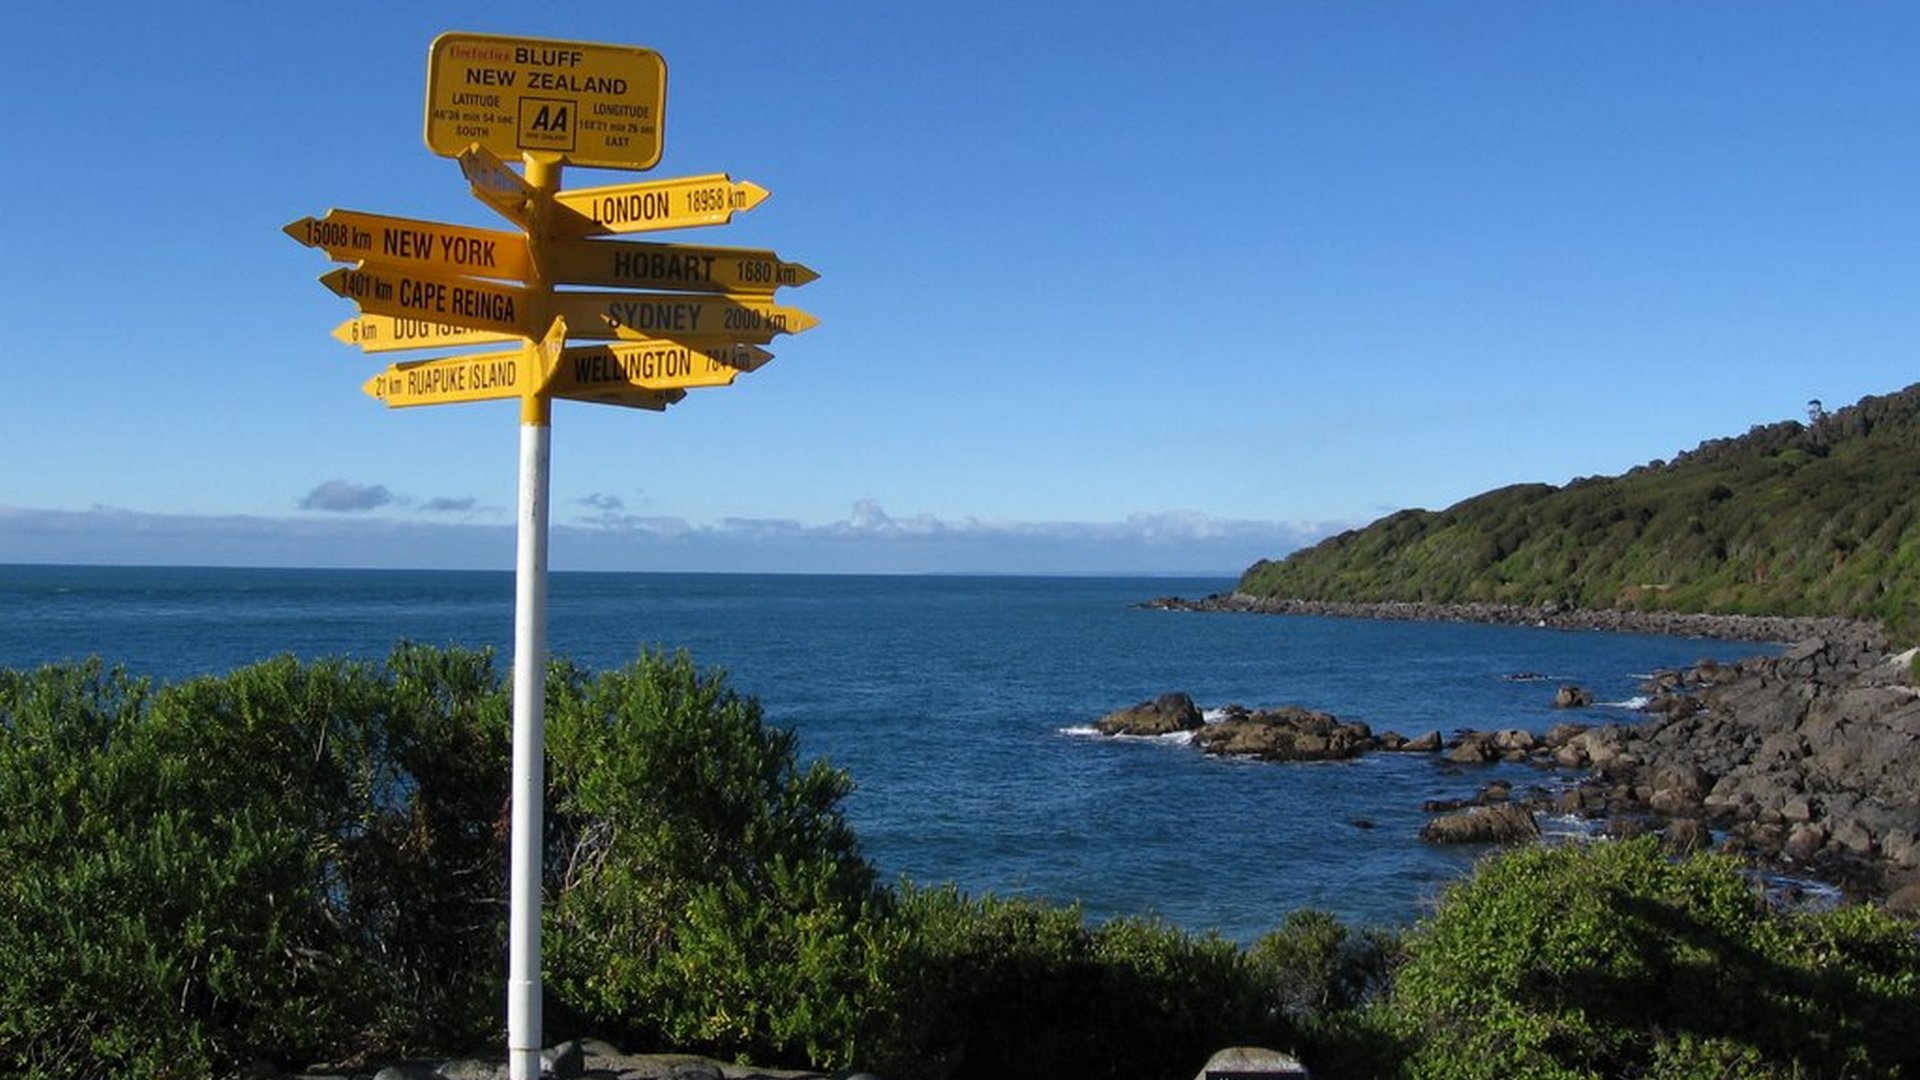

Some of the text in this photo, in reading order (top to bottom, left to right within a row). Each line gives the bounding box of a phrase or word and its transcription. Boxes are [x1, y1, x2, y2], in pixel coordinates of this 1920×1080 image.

[515, 47, 583, 68] BLUFF
[466, 68, 628, 95] NEW ZEALAND
[452, 93, 500, 108] LATITUDE
[593, 103, 649, 118] LONGITUDE
[456, 125, 489, 137] SOUTH
[531, 105, 567, 132] AA
[605, 136, 629, 146] EAST
[593, 187, 746, 224] LONDON 18958 km
[305, 220, 496, 267] 15008 km NEW YORK
[614, 252, 796, 283] HOBART 1680 km
[341, 271, 515, 323] 1401 km CAPE REINGA
[351, 322, 359, 340] 6
[362, 320, 377, 339] km
[608, 303, 787, 331] SYDNEY 2000 km
[376, 361, 516, 396] 21 km RUAPUKE ISLAND
[575, 349, 691, 384] WELLINGTON
